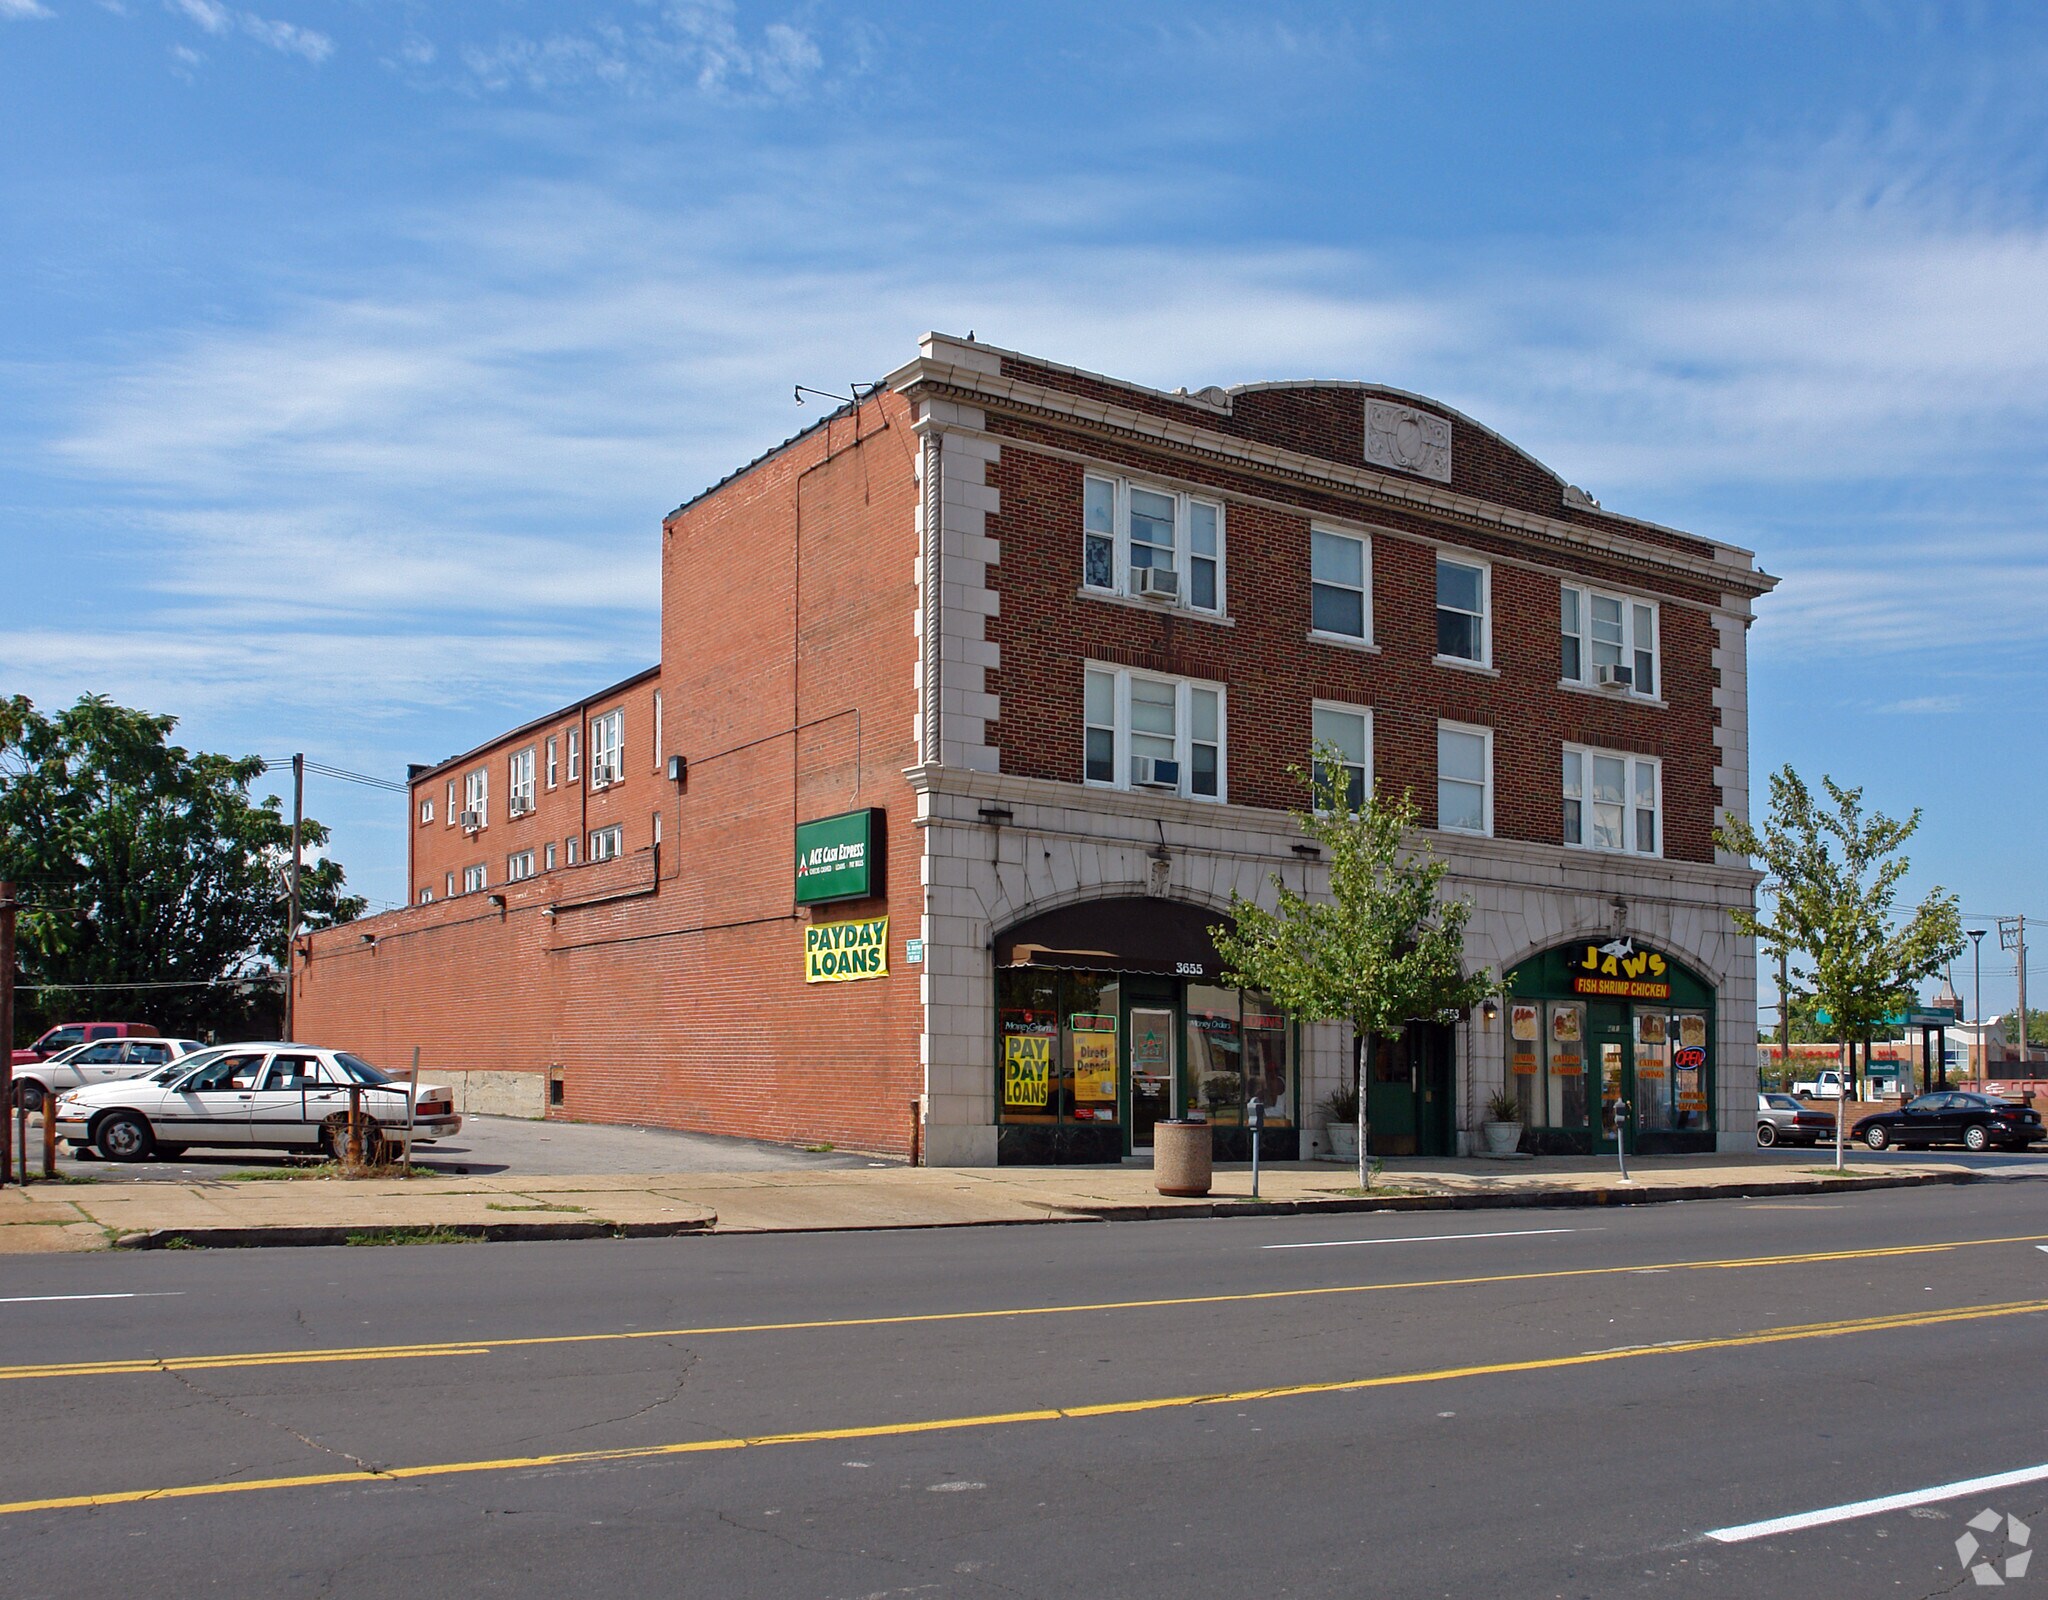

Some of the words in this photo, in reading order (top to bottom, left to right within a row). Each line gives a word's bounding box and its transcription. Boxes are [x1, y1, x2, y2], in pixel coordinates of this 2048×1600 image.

[809, 847, 823, 866] ACE
[807, 920, 886, 952] PAYDAY
[811, 947, 881, 977] LOANS
[1176, 962, 1203, 975] 3655
[1581, 945, 1667, 979] JAWS
[1578, 978, 1598, 993] FISH
[1599, 979, 1630, 996] SHRIMP
[1631, 981, 1668, 998] CHICKEN
[1074, 1016, 1114, 1031] OPEN
[1008, 1037, 1047, 1060] PAY
[1080, 1045, 1109, 1059] Direct
[1676, 1049, 1704, 1068] OPEN
[1006, 1060, 1047, 1082] DAY
[1077, 1060, 1112, 1076] Deposit
[1006, 1081, 1047, 1104] LOANS
